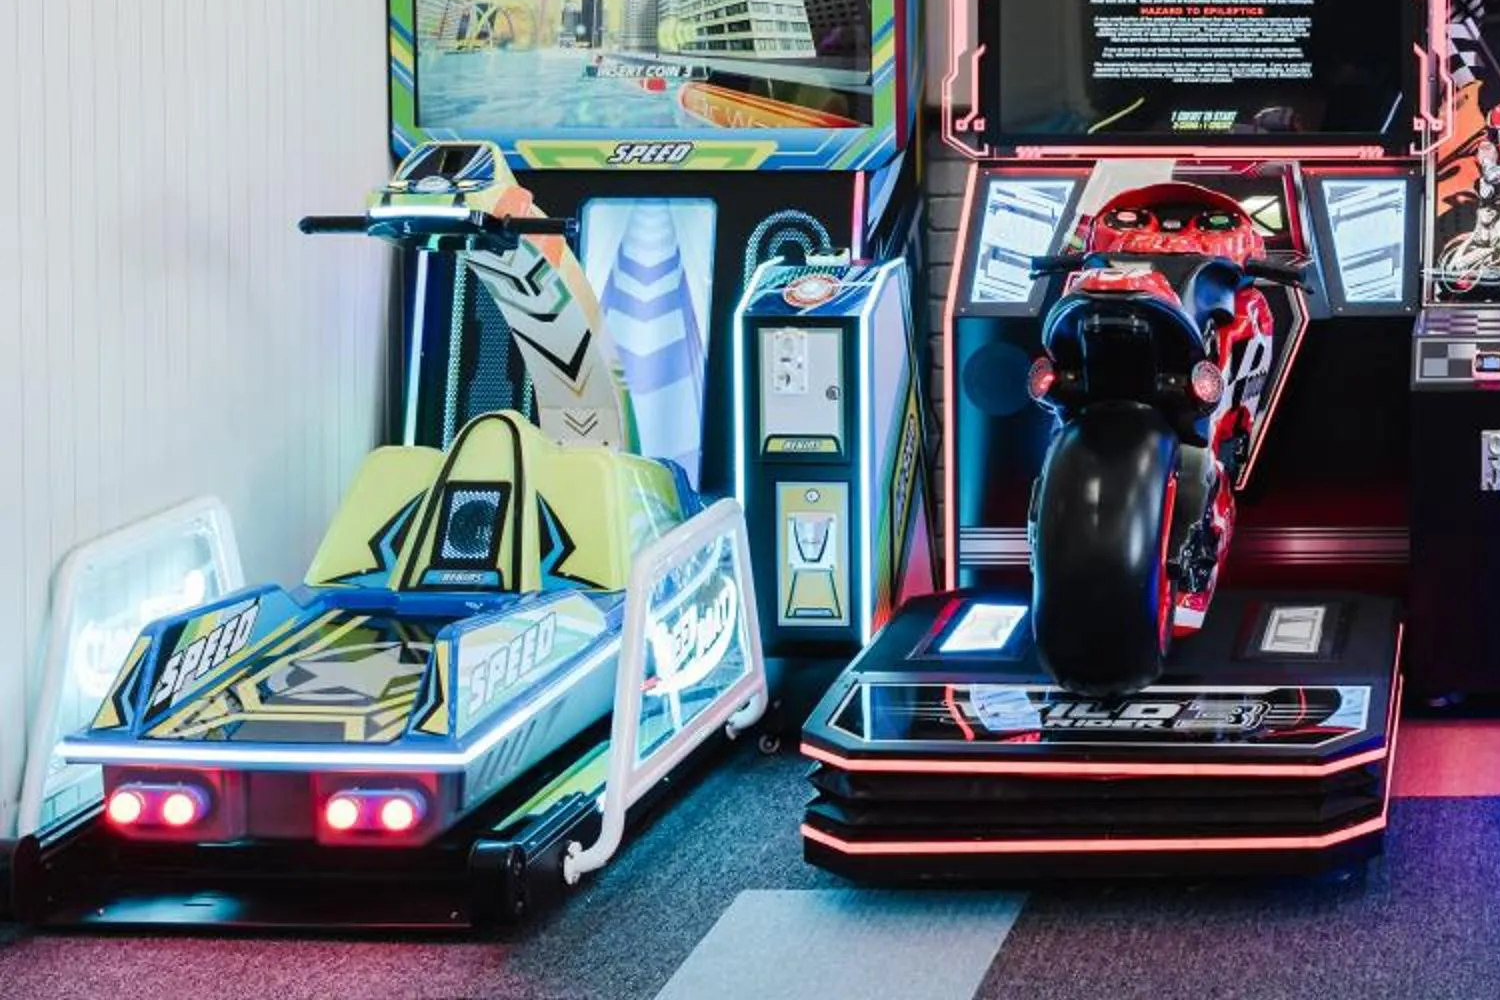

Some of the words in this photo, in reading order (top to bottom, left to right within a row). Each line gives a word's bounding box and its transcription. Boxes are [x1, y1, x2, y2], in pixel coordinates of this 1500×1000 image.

[1140, 6, 1183, 17] HAZARD
[1186, 6, 1201, 17] TO
[607, 140, 697, 166] SPEED
[153, 602, 260, 707] SPEED
[469, 611, 557, 717] SPEED
